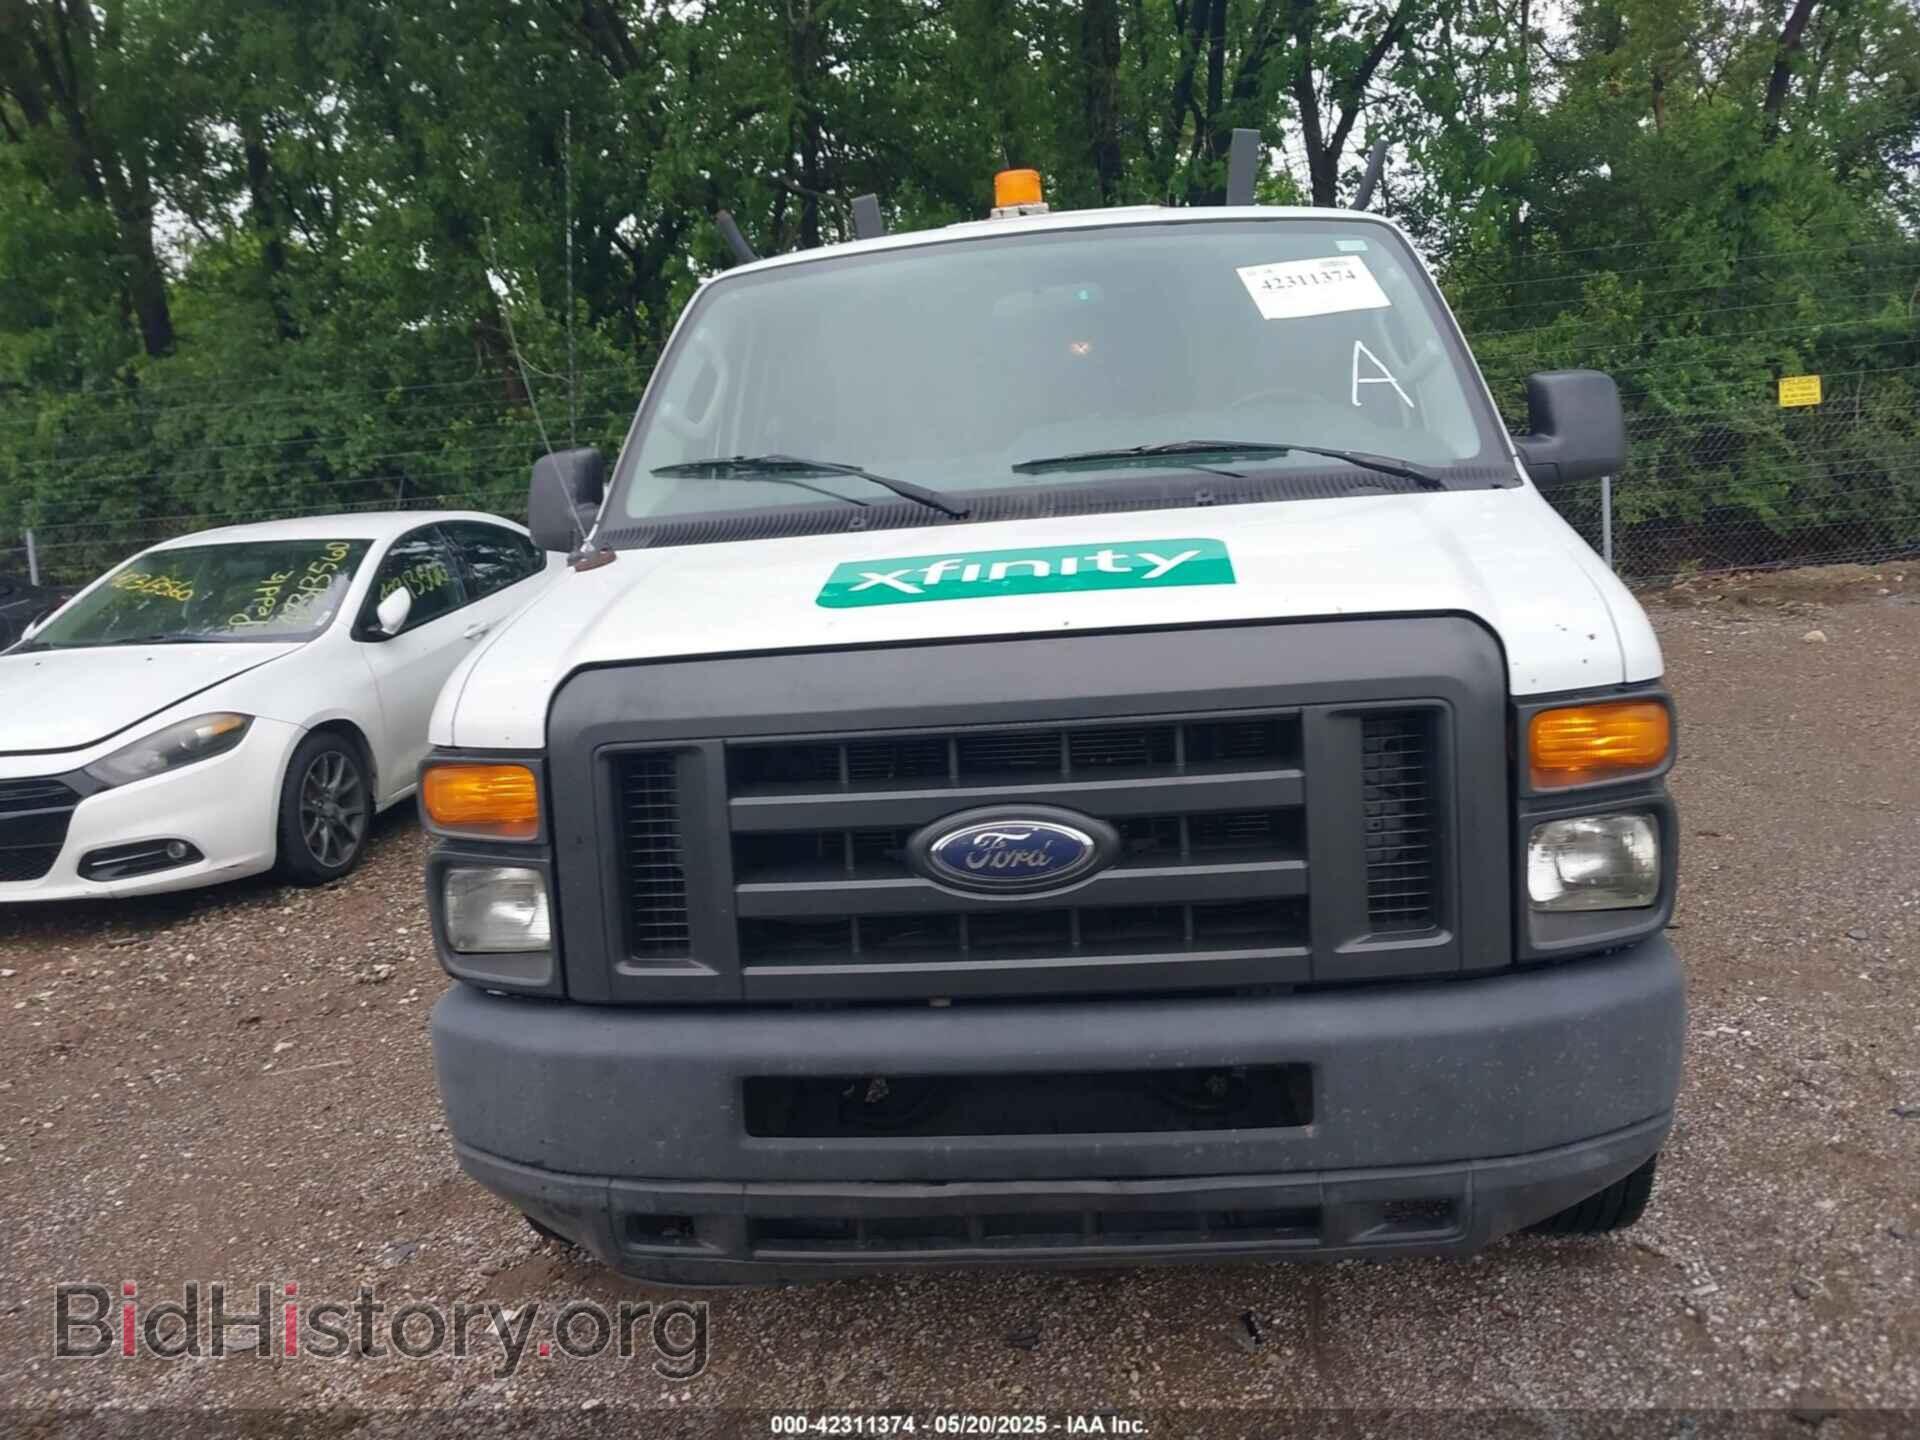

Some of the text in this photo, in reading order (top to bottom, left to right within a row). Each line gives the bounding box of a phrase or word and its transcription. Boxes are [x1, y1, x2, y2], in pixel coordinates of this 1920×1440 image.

[1261, 269, 1357, 290] 42311374
[1351, 340, 1415, 408] A
[847, 548, 1201, 594] xfinity
[965, 831, 1054, 870] Ford
